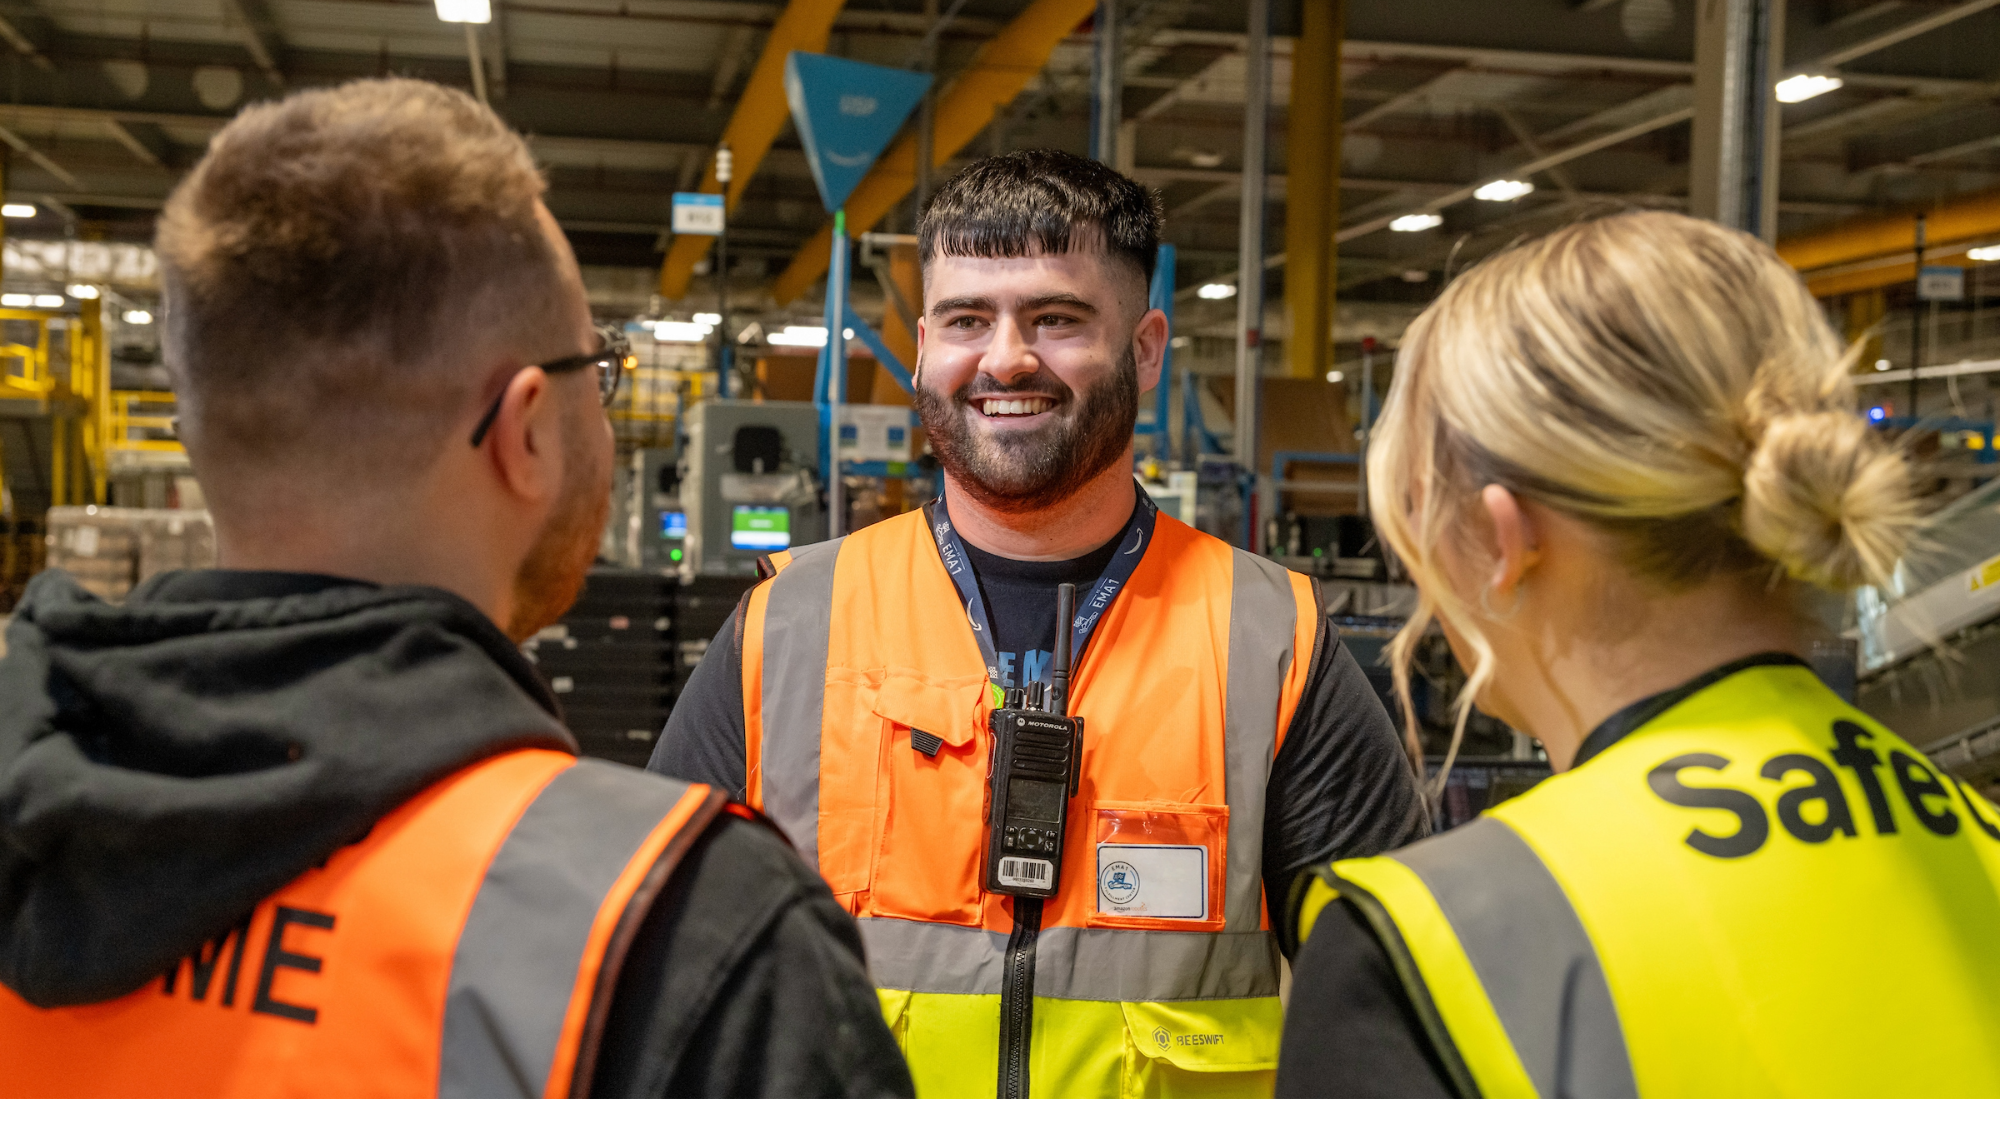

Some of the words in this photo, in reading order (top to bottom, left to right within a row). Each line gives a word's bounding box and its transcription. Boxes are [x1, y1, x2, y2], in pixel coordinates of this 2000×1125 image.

[942, 542, 962, 575] EMA1
[1092, 578, 1120, 609] EMA1
[996, 652, 1016, 688] E
[1027, 721, 1068, 731] MOTOROLA
[1176, 1034, 1225, 1046] BEESWIFT
